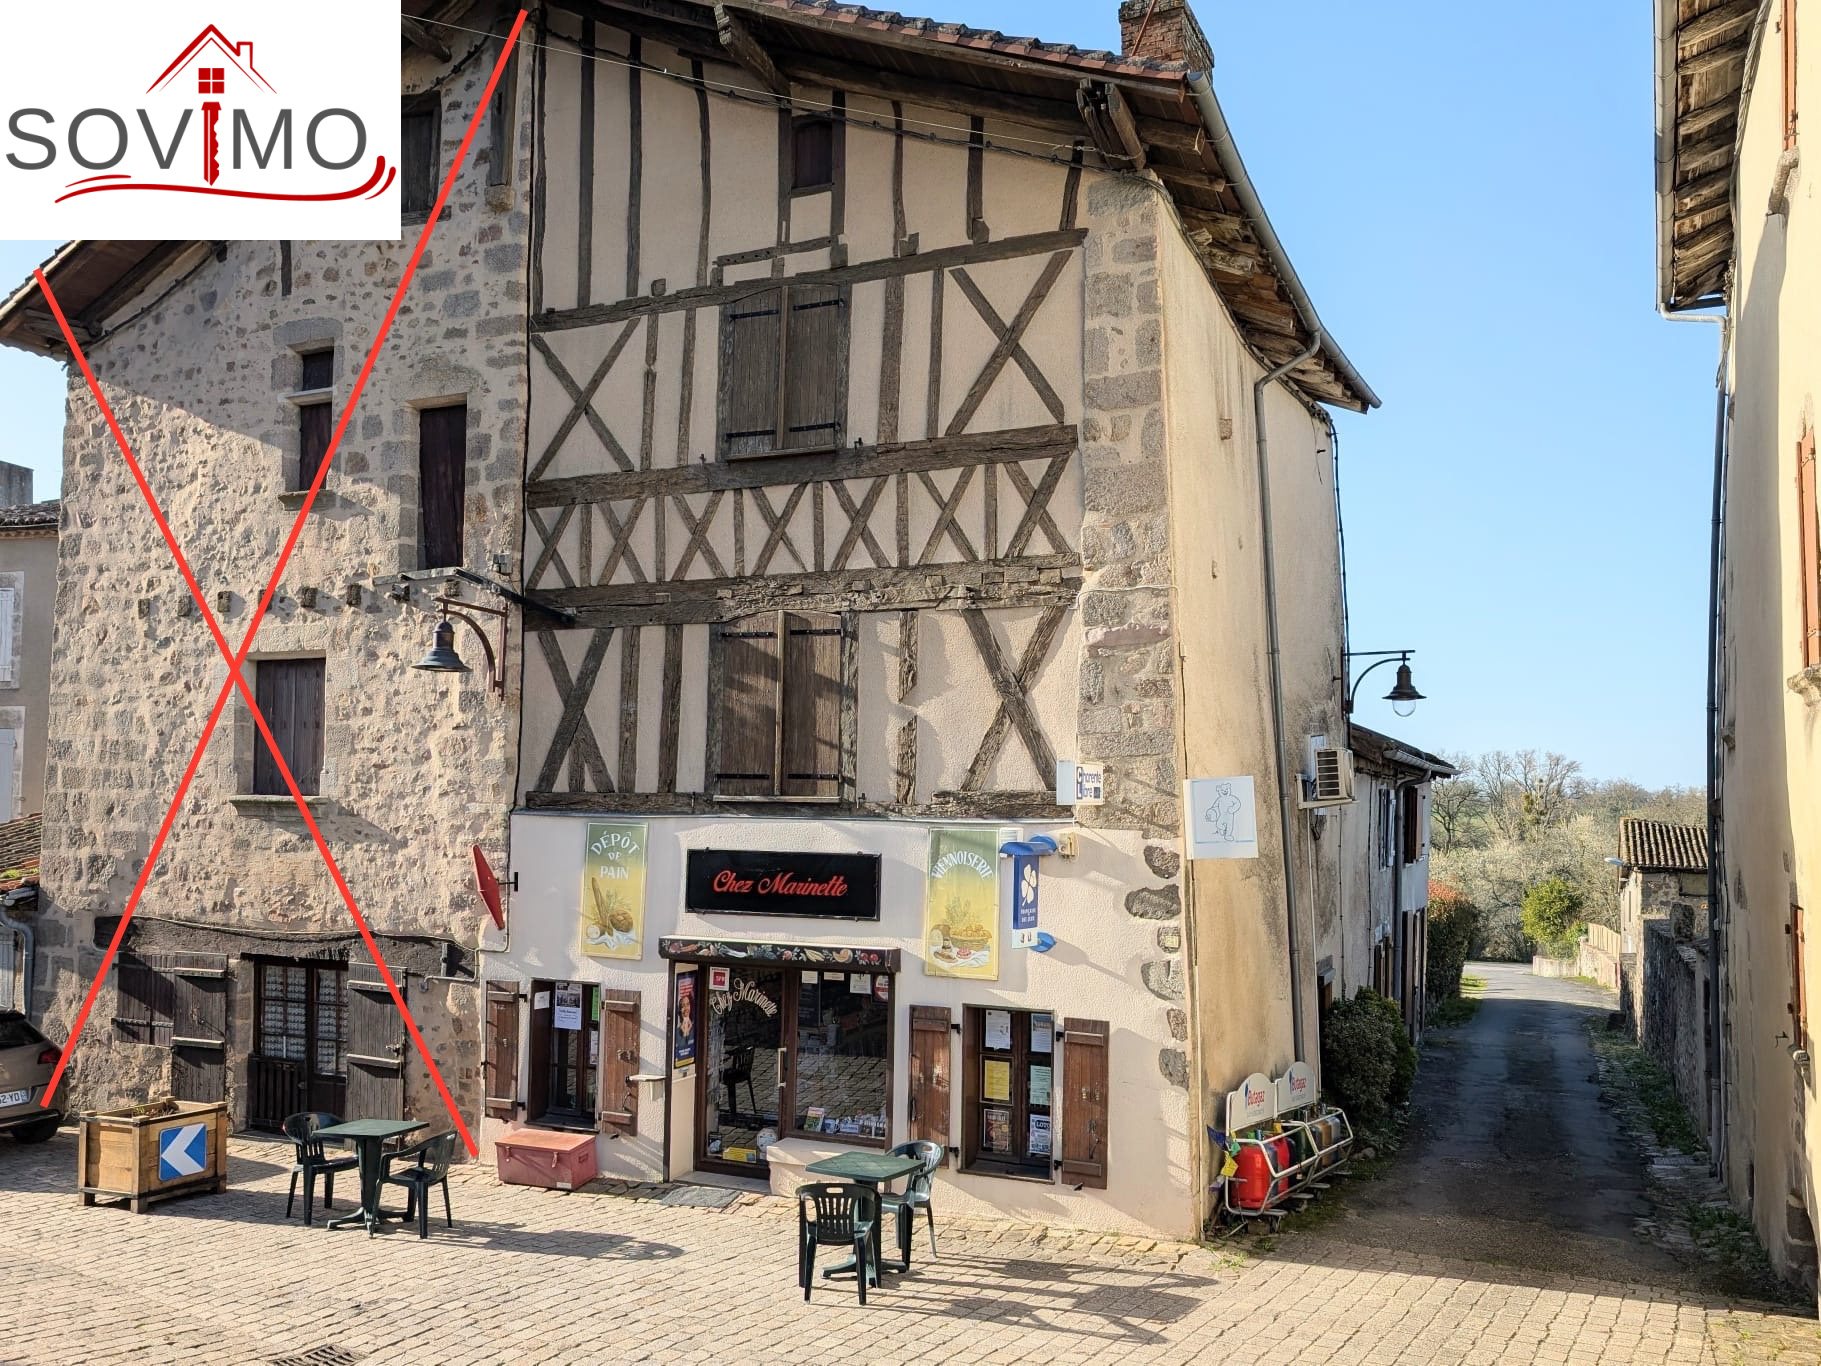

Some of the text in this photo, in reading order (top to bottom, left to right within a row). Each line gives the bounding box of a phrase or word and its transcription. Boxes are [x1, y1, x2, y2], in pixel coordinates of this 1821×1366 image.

[590, 831, 640, 856] DÉPÔT
[607, 851, 622, 861] DE
[600, 865, 630, 880] PAIN
[931, 850, 994, 880] VIENNOISERIE
[713, 869, 848, 897] Chez Marinette
[711, 977, 778, 1018] Chez Marinette
[0, 1092, 20, 1104] 2-YD
